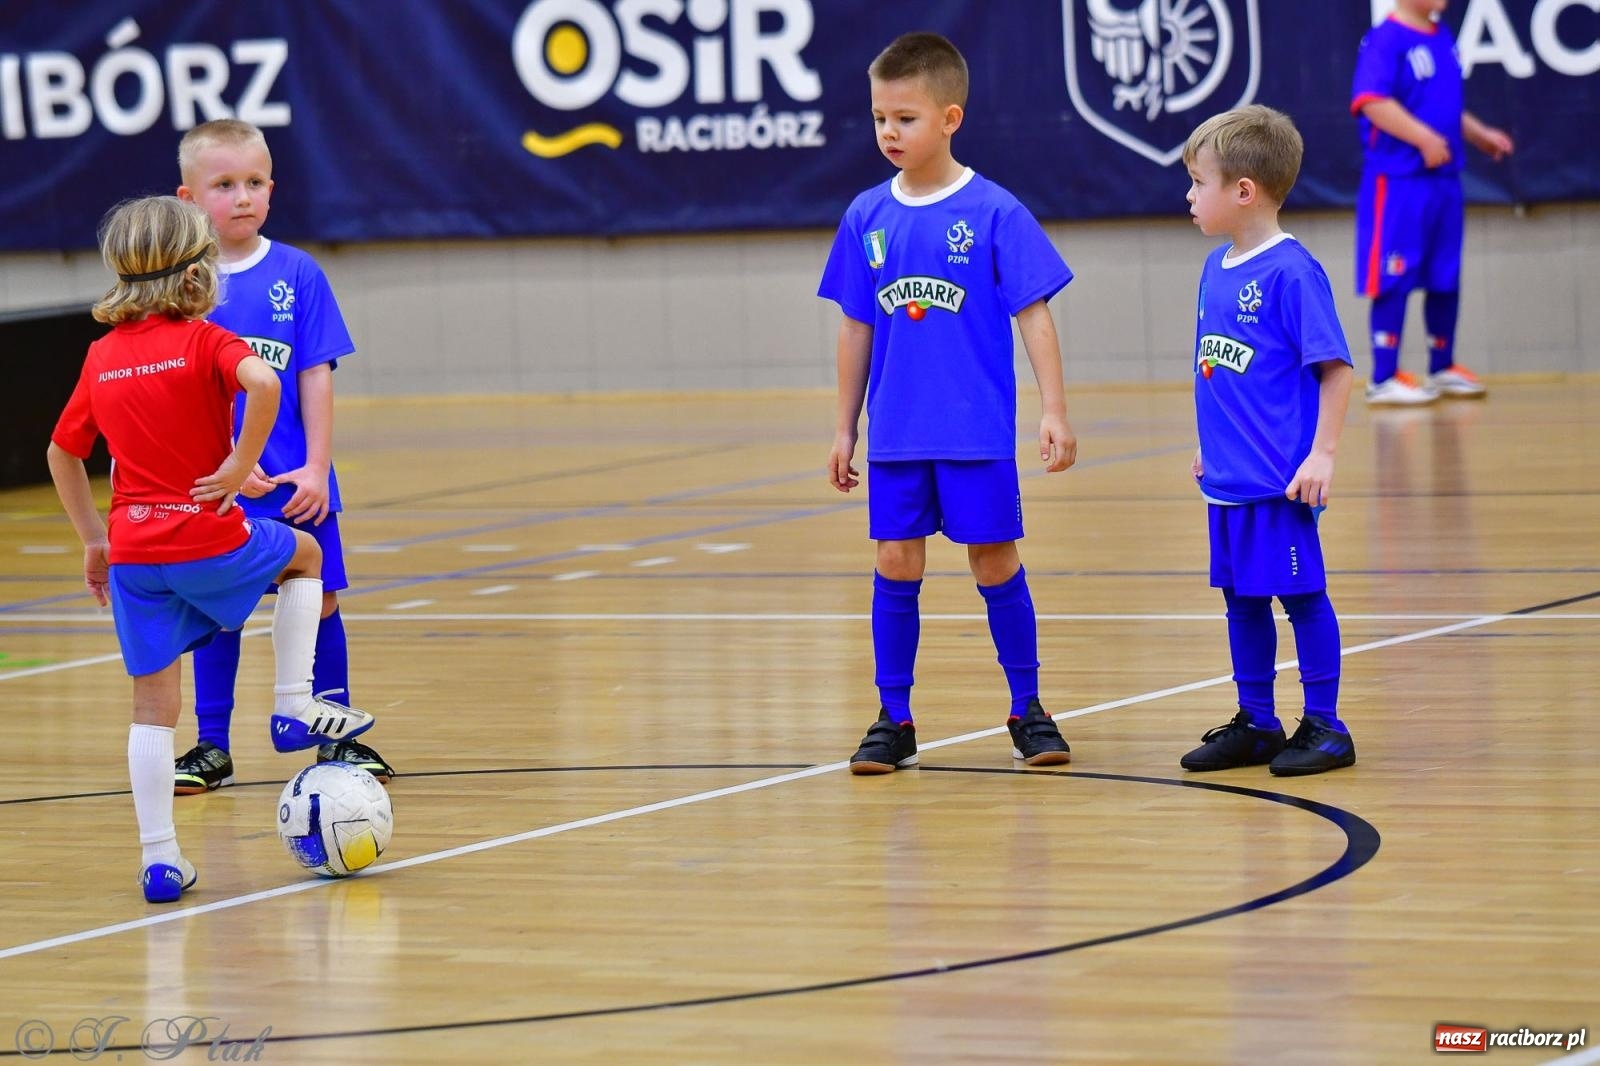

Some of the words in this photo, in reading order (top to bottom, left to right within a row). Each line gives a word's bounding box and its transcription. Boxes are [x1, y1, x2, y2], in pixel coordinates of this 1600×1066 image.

[511, 0, 823, 110] OSiR
[636, 104, 825, 152] RACIBÓRZ
[947, 255, 970, 264] PZPN
[272, 312, 294, 322] PZPN
[1236, 314, 1259, 324] PZPN
[98, 368, 132, 383] JUNIOR
[135, 357, 186, 376] TRENING
[154, 511, 170, 520] 1217
[1289, 546, 1298, 576] KIPSTA
